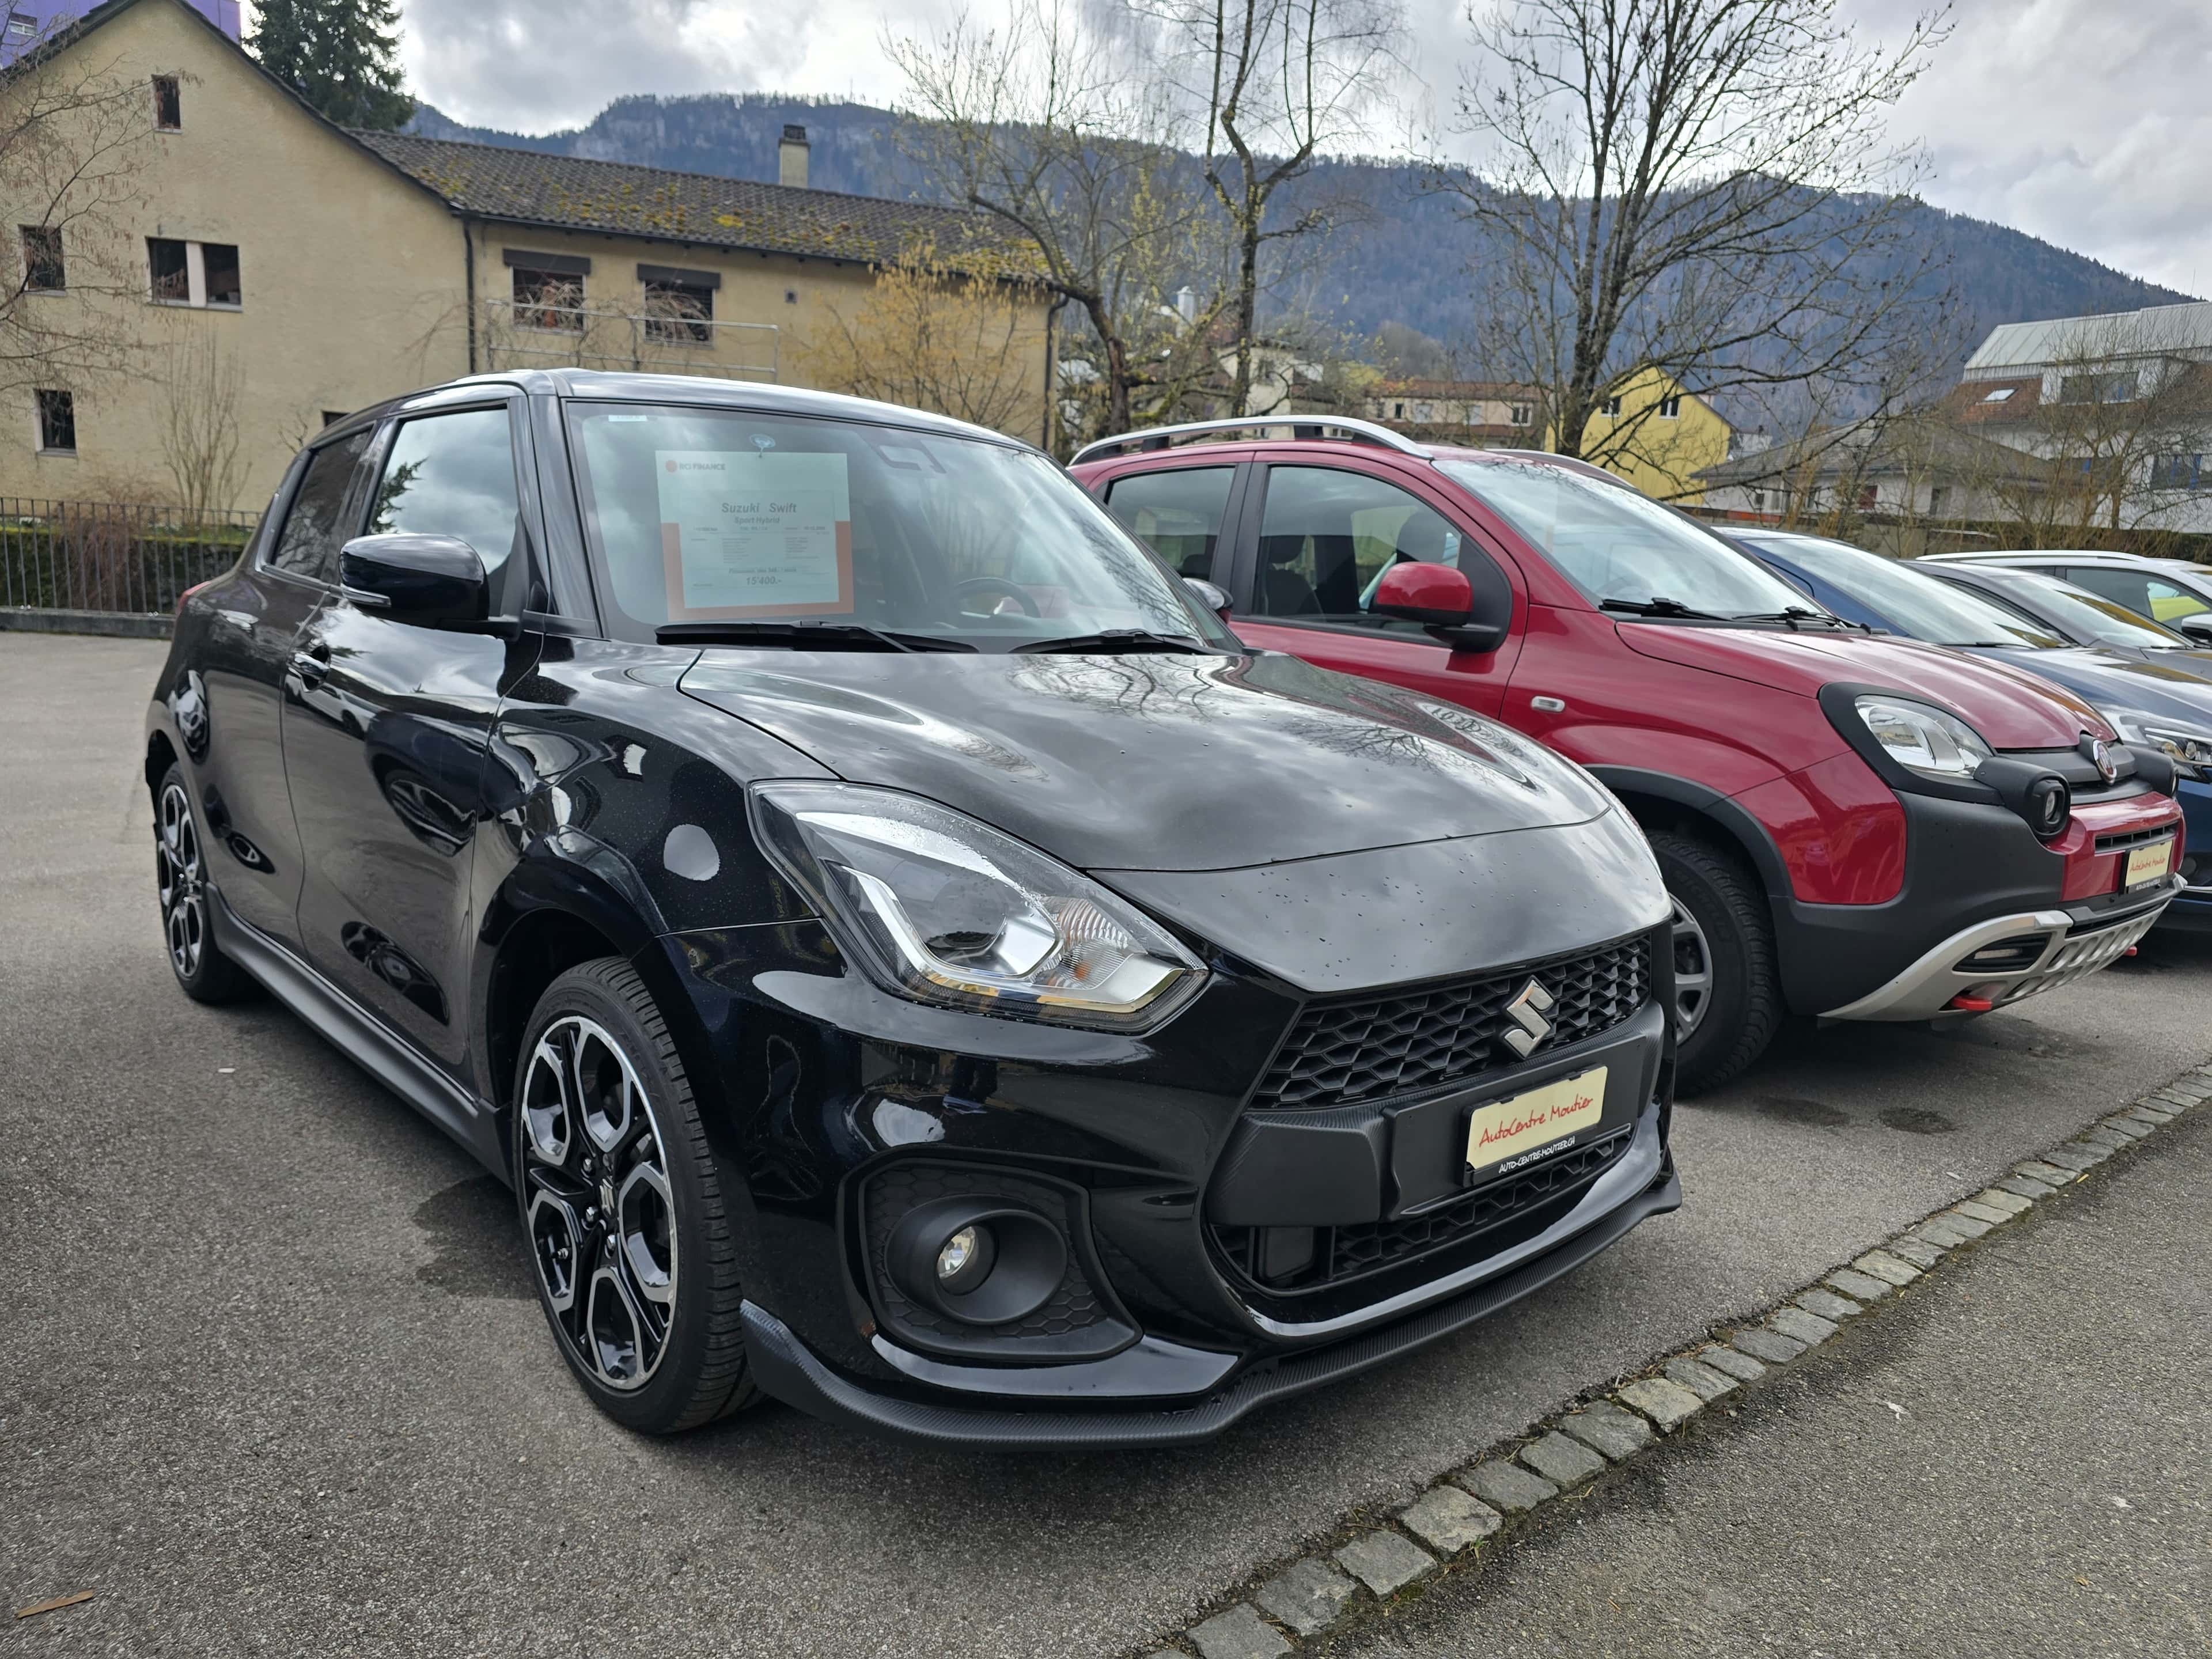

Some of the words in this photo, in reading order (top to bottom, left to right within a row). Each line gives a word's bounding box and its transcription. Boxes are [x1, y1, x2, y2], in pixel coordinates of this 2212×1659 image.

[721, 502, 760, 513] Suzuki
[769, 502, 797, 513] Swift
[756, 516, 780, 524] Hybrid
[1479, 1109, 1546, 1147] AutoCentre
[1550, 1093, 1593, 1122] Moutier
